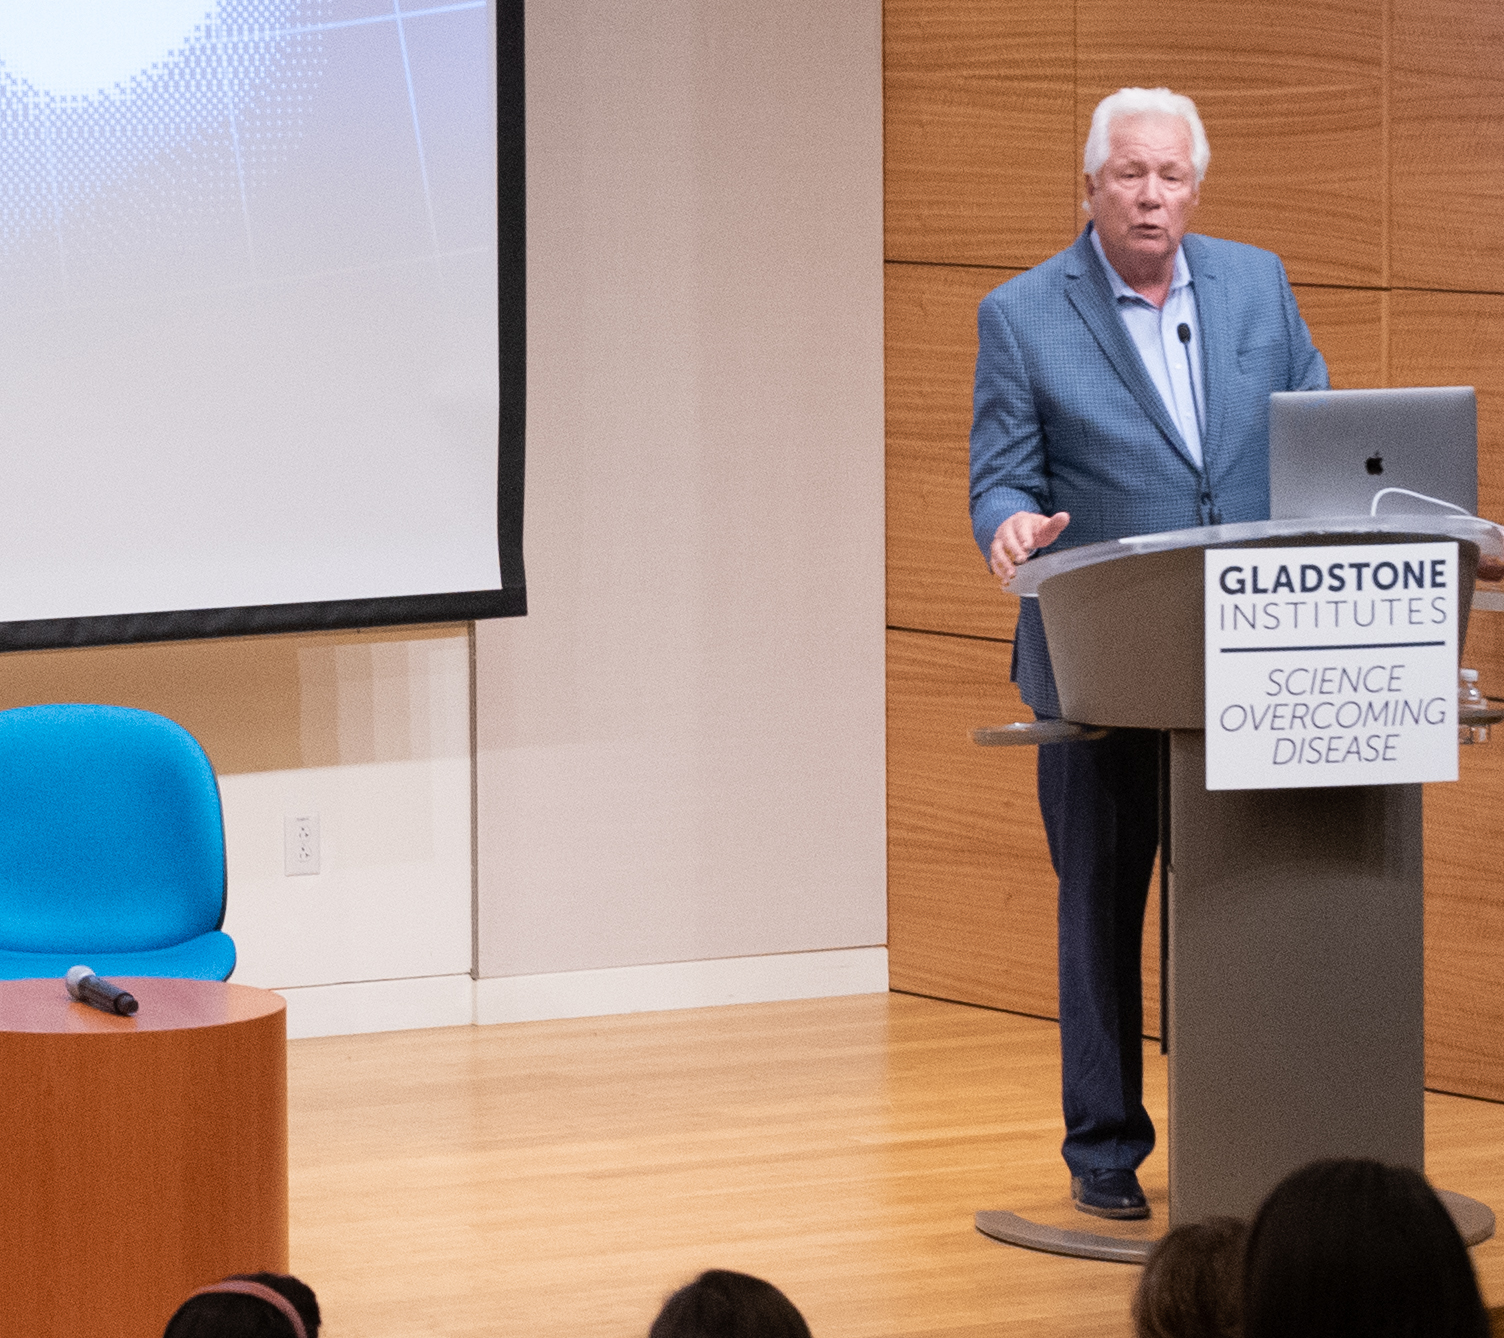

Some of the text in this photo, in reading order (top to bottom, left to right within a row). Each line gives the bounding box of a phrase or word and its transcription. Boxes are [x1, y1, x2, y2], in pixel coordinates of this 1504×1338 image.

[1219, 559, 1447, 595] GLADSTONE
[1219, 596, 1447, 631] INSTITUTES
[1265, 664, 1406, 697] SCIENCE
[1219, 697, 1447, 732] OVERCOMING
[1272, 734, 1401, 766] DISEASE
